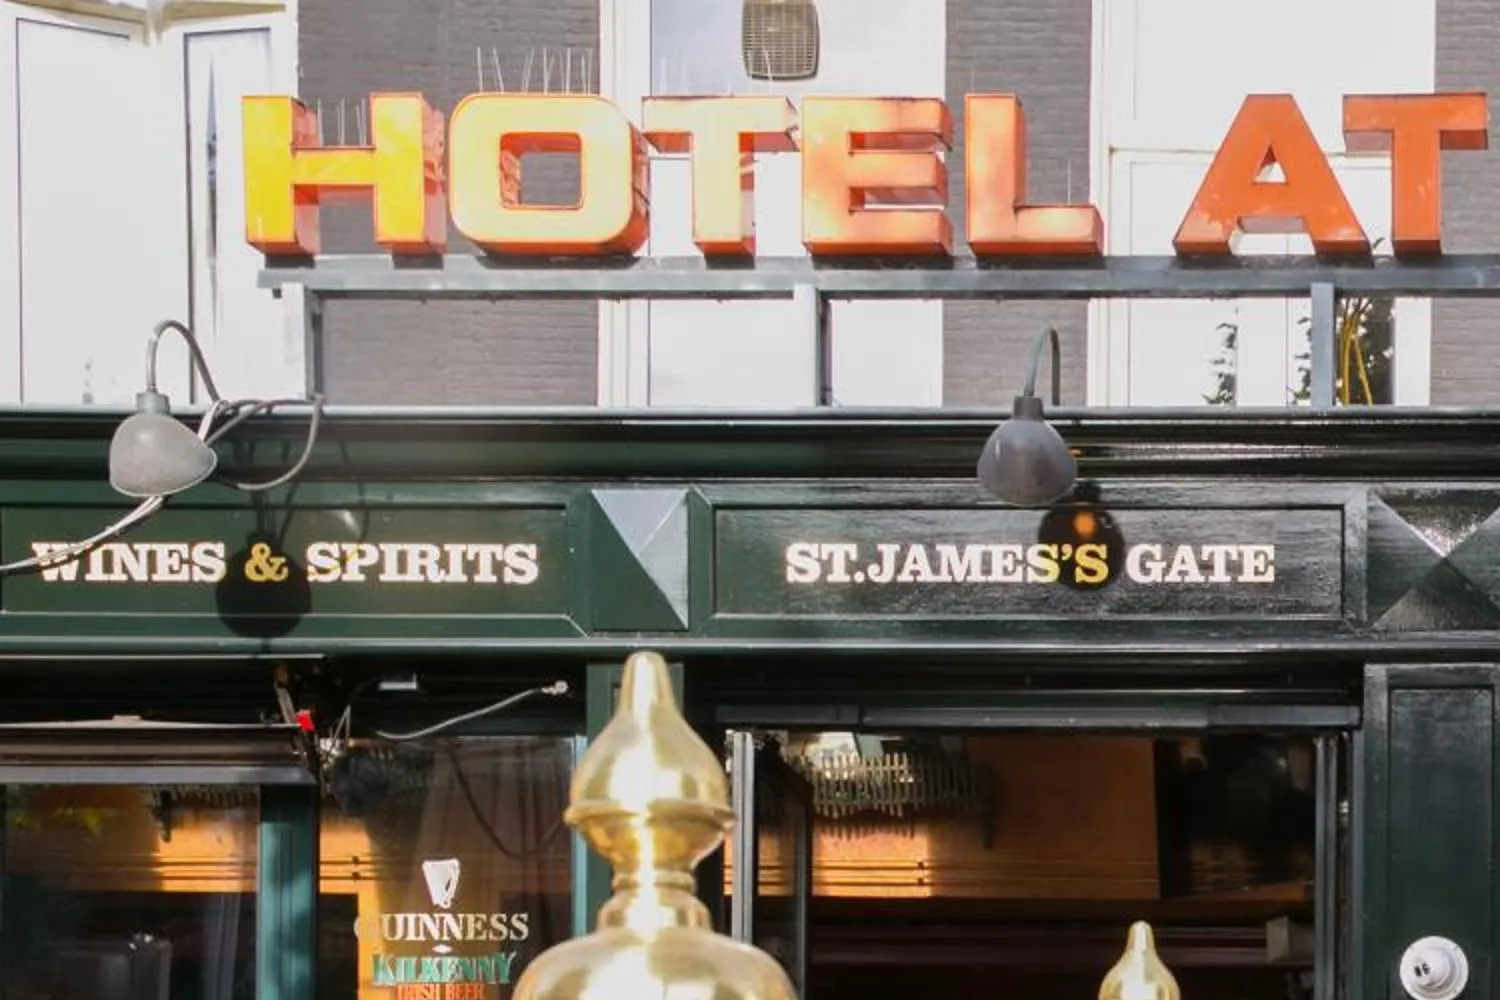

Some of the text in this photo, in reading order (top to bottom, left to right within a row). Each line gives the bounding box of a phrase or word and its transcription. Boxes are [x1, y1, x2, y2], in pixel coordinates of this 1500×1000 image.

[241, 92, 1106, 256] HOTEL
[31, 541, 540, 585] WINES & SPIRITS
[784, 541, 1277, 585] ST.JAMES'S GATE
[443, 983, 487, 1000] BEER
